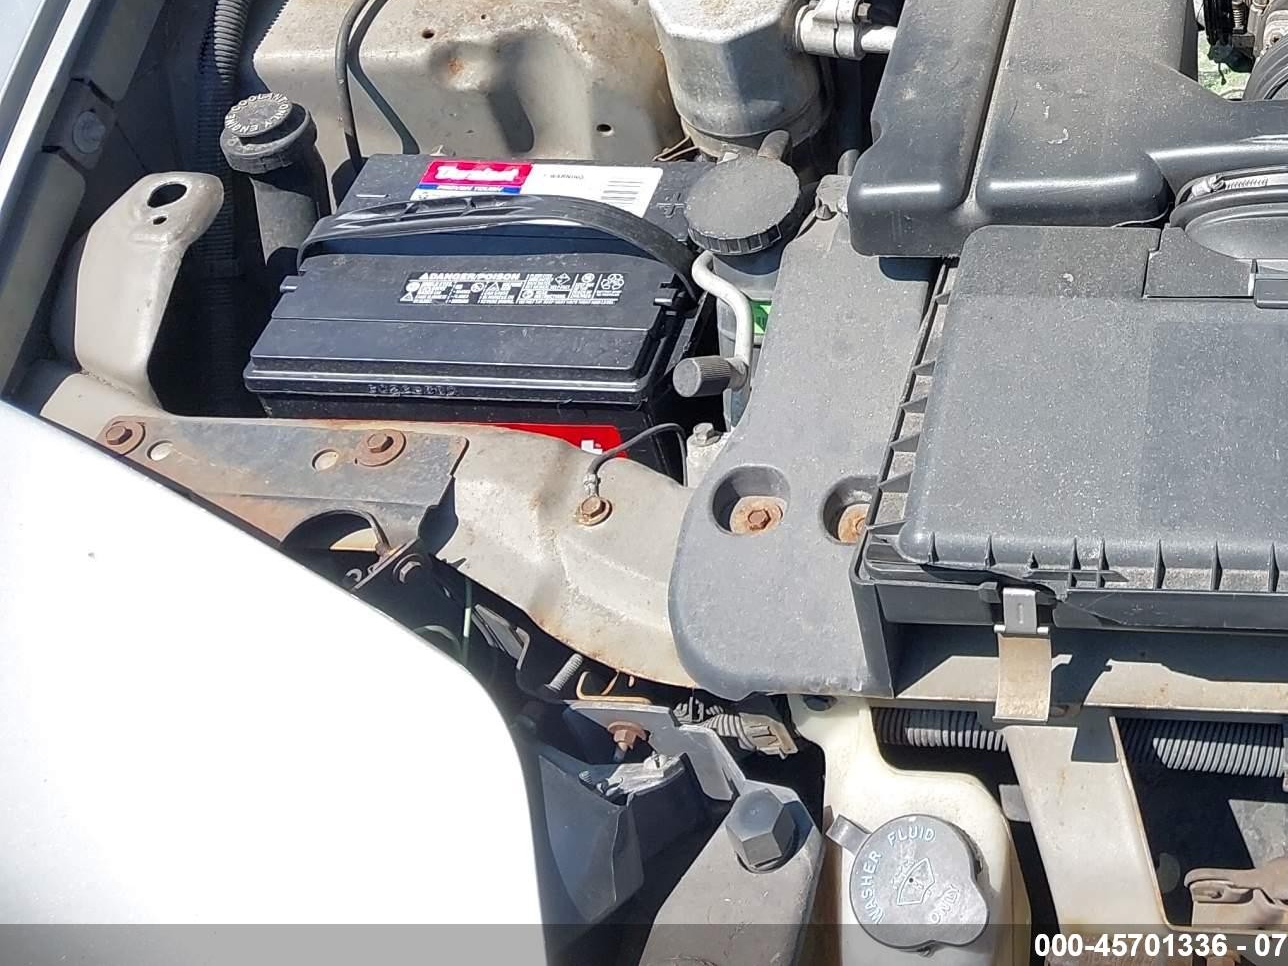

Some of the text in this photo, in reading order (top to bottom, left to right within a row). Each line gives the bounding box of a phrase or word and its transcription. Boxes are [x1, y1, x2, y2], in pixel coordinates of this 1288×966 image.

[225, 92, 289, 134] ENGINE COOLANT ONLY
[428, 272, 521, 280] DANGER/POISON
[861, 825, 962, 926] WASHER FLUID ONLY
